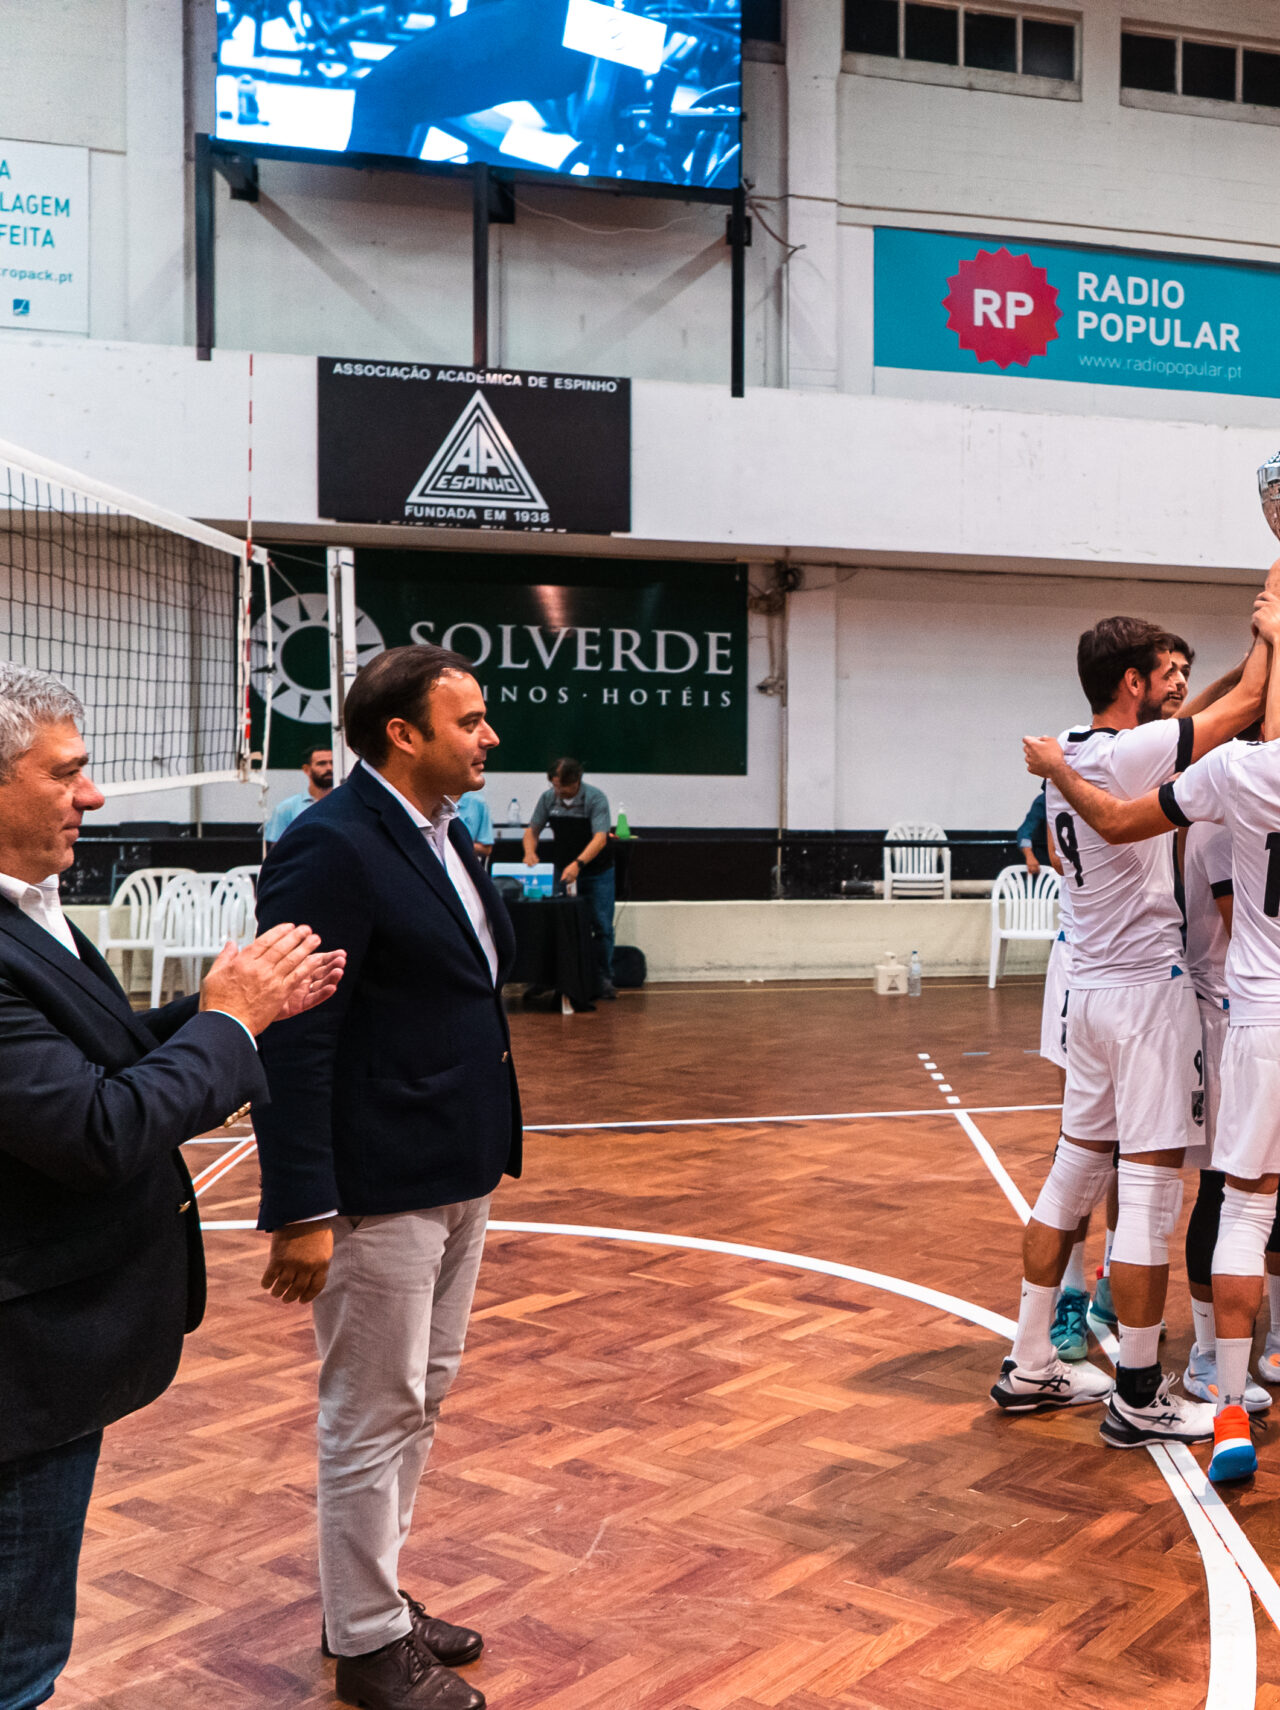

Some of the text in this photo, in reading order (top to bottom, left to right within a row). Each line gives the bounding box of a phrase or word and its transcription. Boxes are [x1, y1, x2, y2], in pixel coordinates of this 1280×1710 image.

[0, 268, 73, 284] ropack.pt
[1078, 272, 1185, 310] RADIO
[974, 289, 1034, 330] RP
[1078, 311, 1241, 353] POPULAR
[333, 362, 431, 382] ASSOCIAÇÃO
[528, 376, 548, 388] DE
[554, 377, 619, 393] ESPINHO
[1078, 354, 1243, 382] www.radiopopular.pt
[435, 475, 521, 493] ESPINHO
[404, 505, 550, 523] FUNDADA EM 1938
[409, 621, 734, 675] SOLVERDE
[483, 684, 732, 708] INOS HOTÉIS
[1055, 812, 1084, 887] 9
